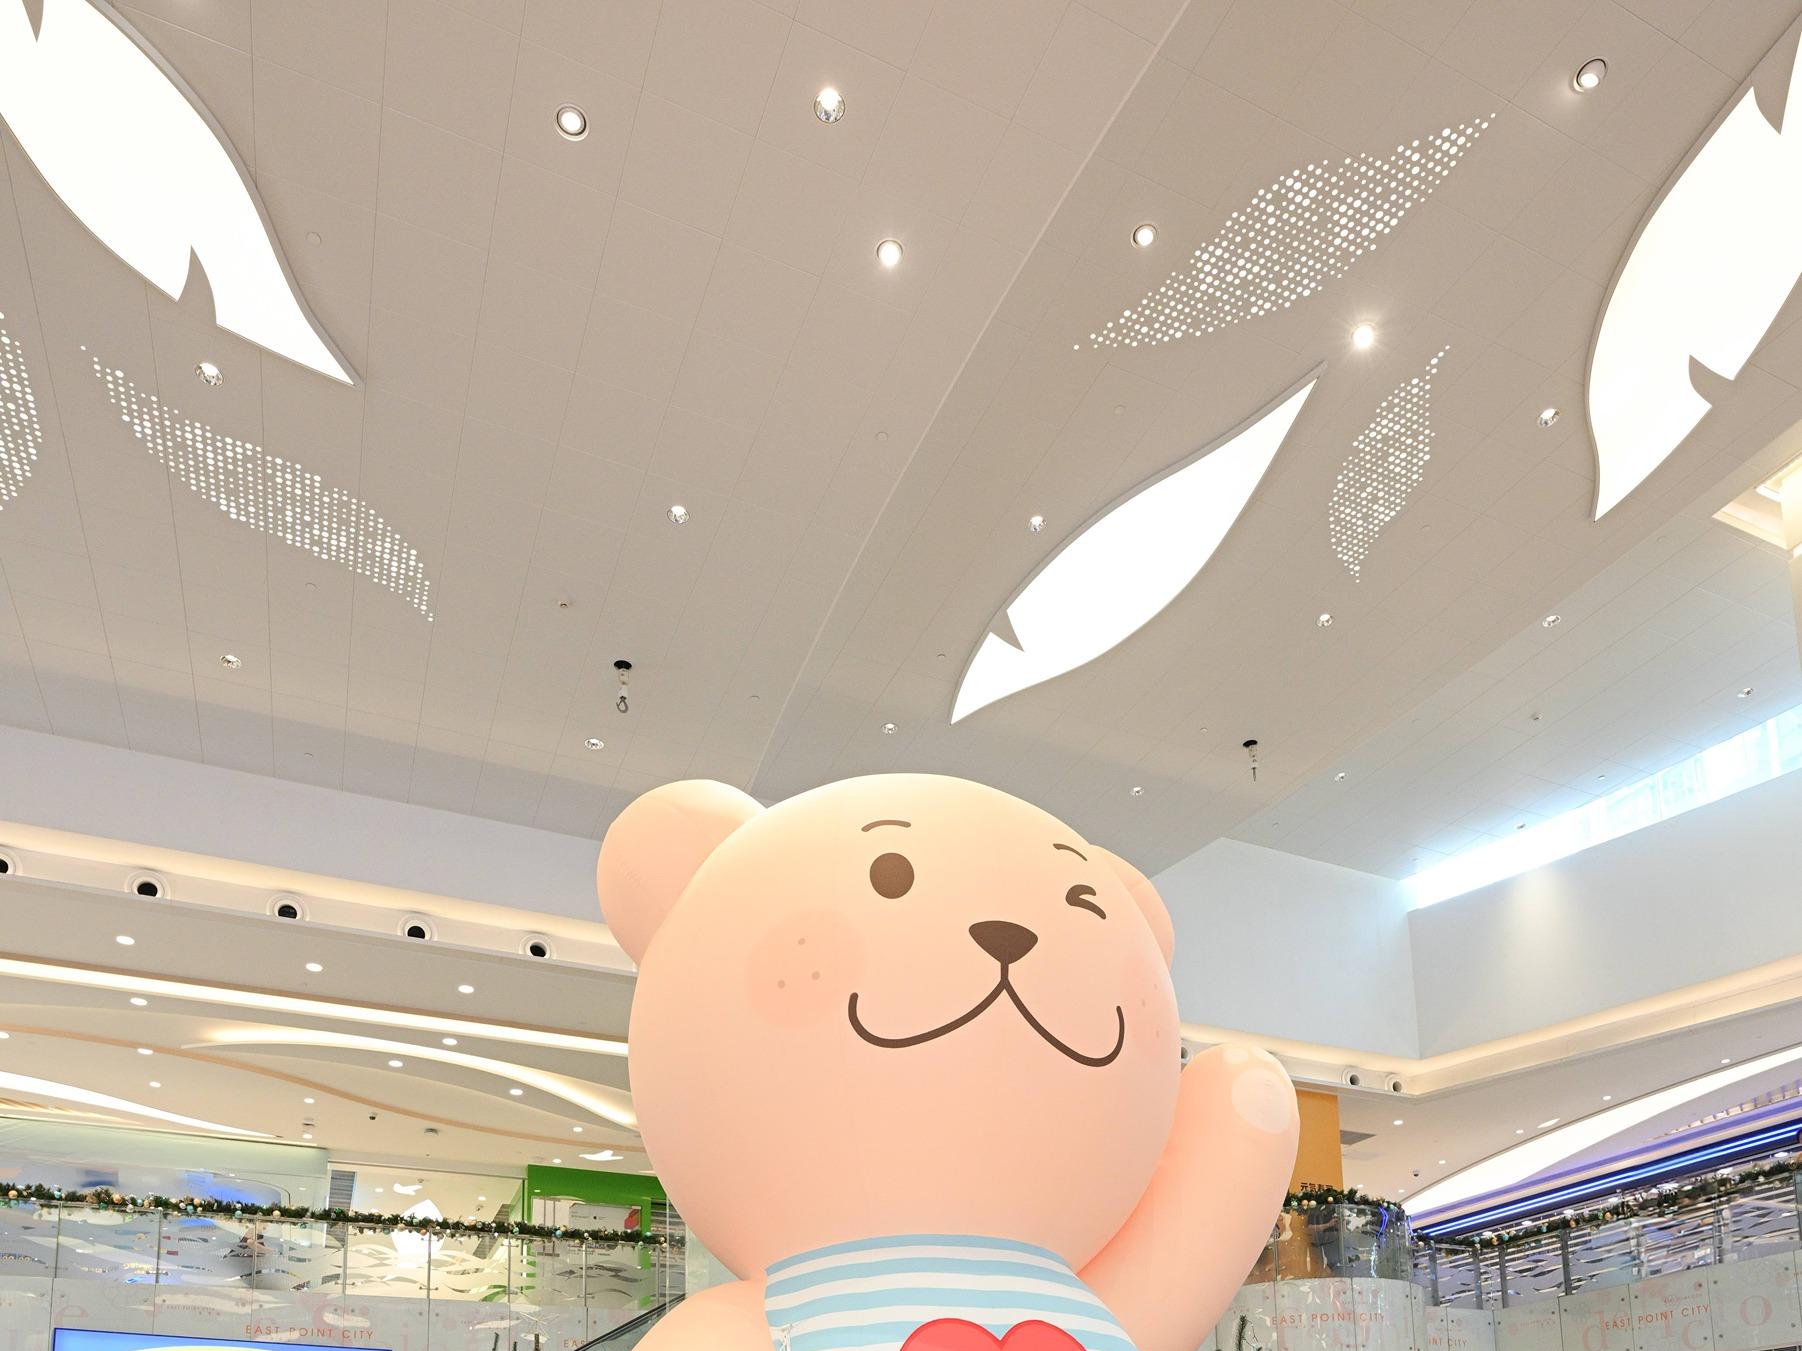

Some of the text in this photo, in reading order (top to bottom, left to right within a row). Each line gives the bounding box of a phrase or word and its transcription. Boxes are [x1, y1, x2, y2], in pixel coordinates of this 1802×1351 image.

[1271, 1312, 1385, 1325] EAST POINT CITY
[1605, 1304, 1710, 1330] EAST POINT CITY
[245, 1324, 374, 1340] EAST POINT CITY
[563, 1339, 587, 1348] EAS
[1428, 1338, 1468, 1347] INT CITY
